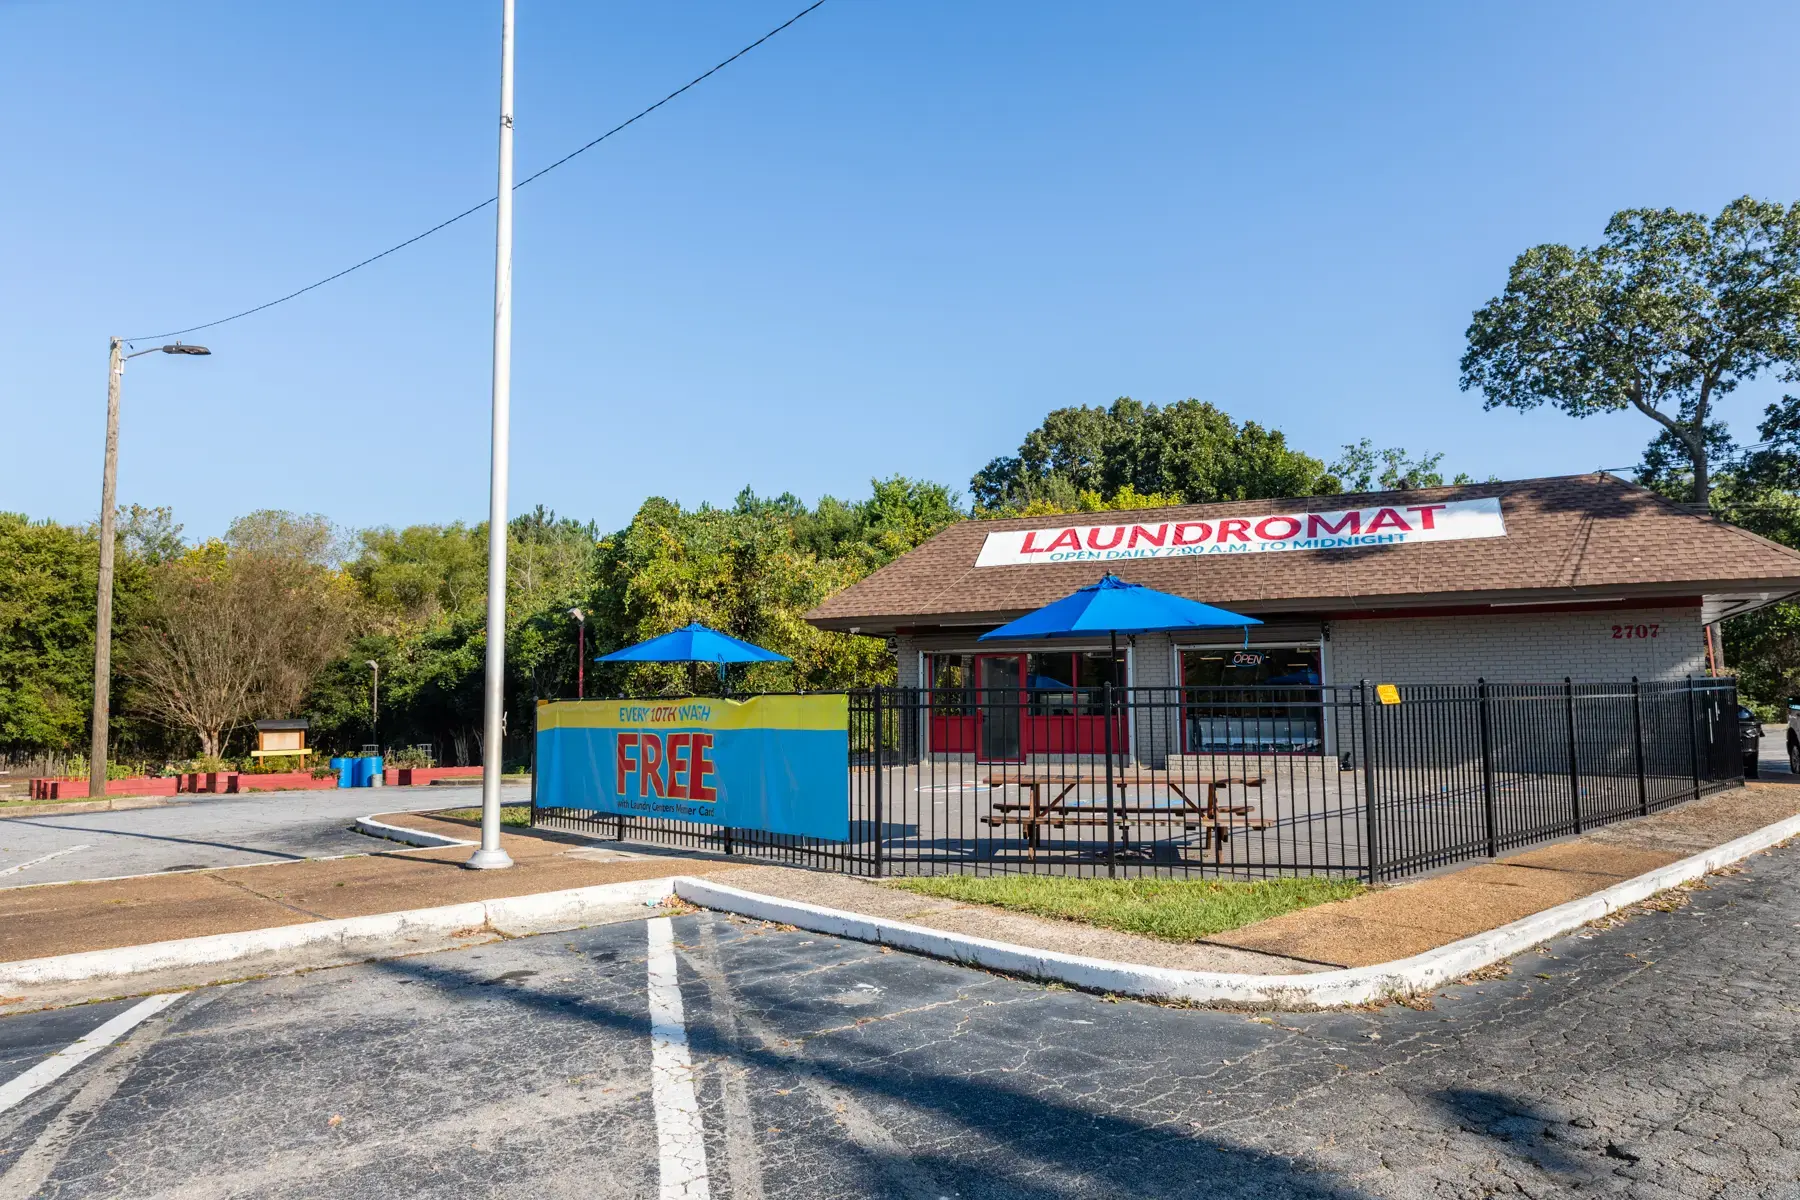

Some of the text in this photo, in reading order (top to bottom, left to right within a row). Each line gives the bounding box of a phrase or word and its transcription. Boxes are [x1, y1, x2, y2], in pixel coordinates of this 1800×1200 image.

[1020, 504, 1446, 554] LAUNDROMAT
[1049, 532, 1408, 562] OPEN DAILY 7:00 A.M. TO MIDNIGHT
[1611, 624, 1659, 639] 2707
[1233, 653, 1263, 665] OPEN
[619, 704, 711, 722] EVERY 10TH WASH
[617, 732, 717, 803] FREE
[617, 800, 630, 808] with
[630, 800, 652, 812] Laundry
[651, 802, 675, 813] Centers
[698, 805, 715, 817] Card
